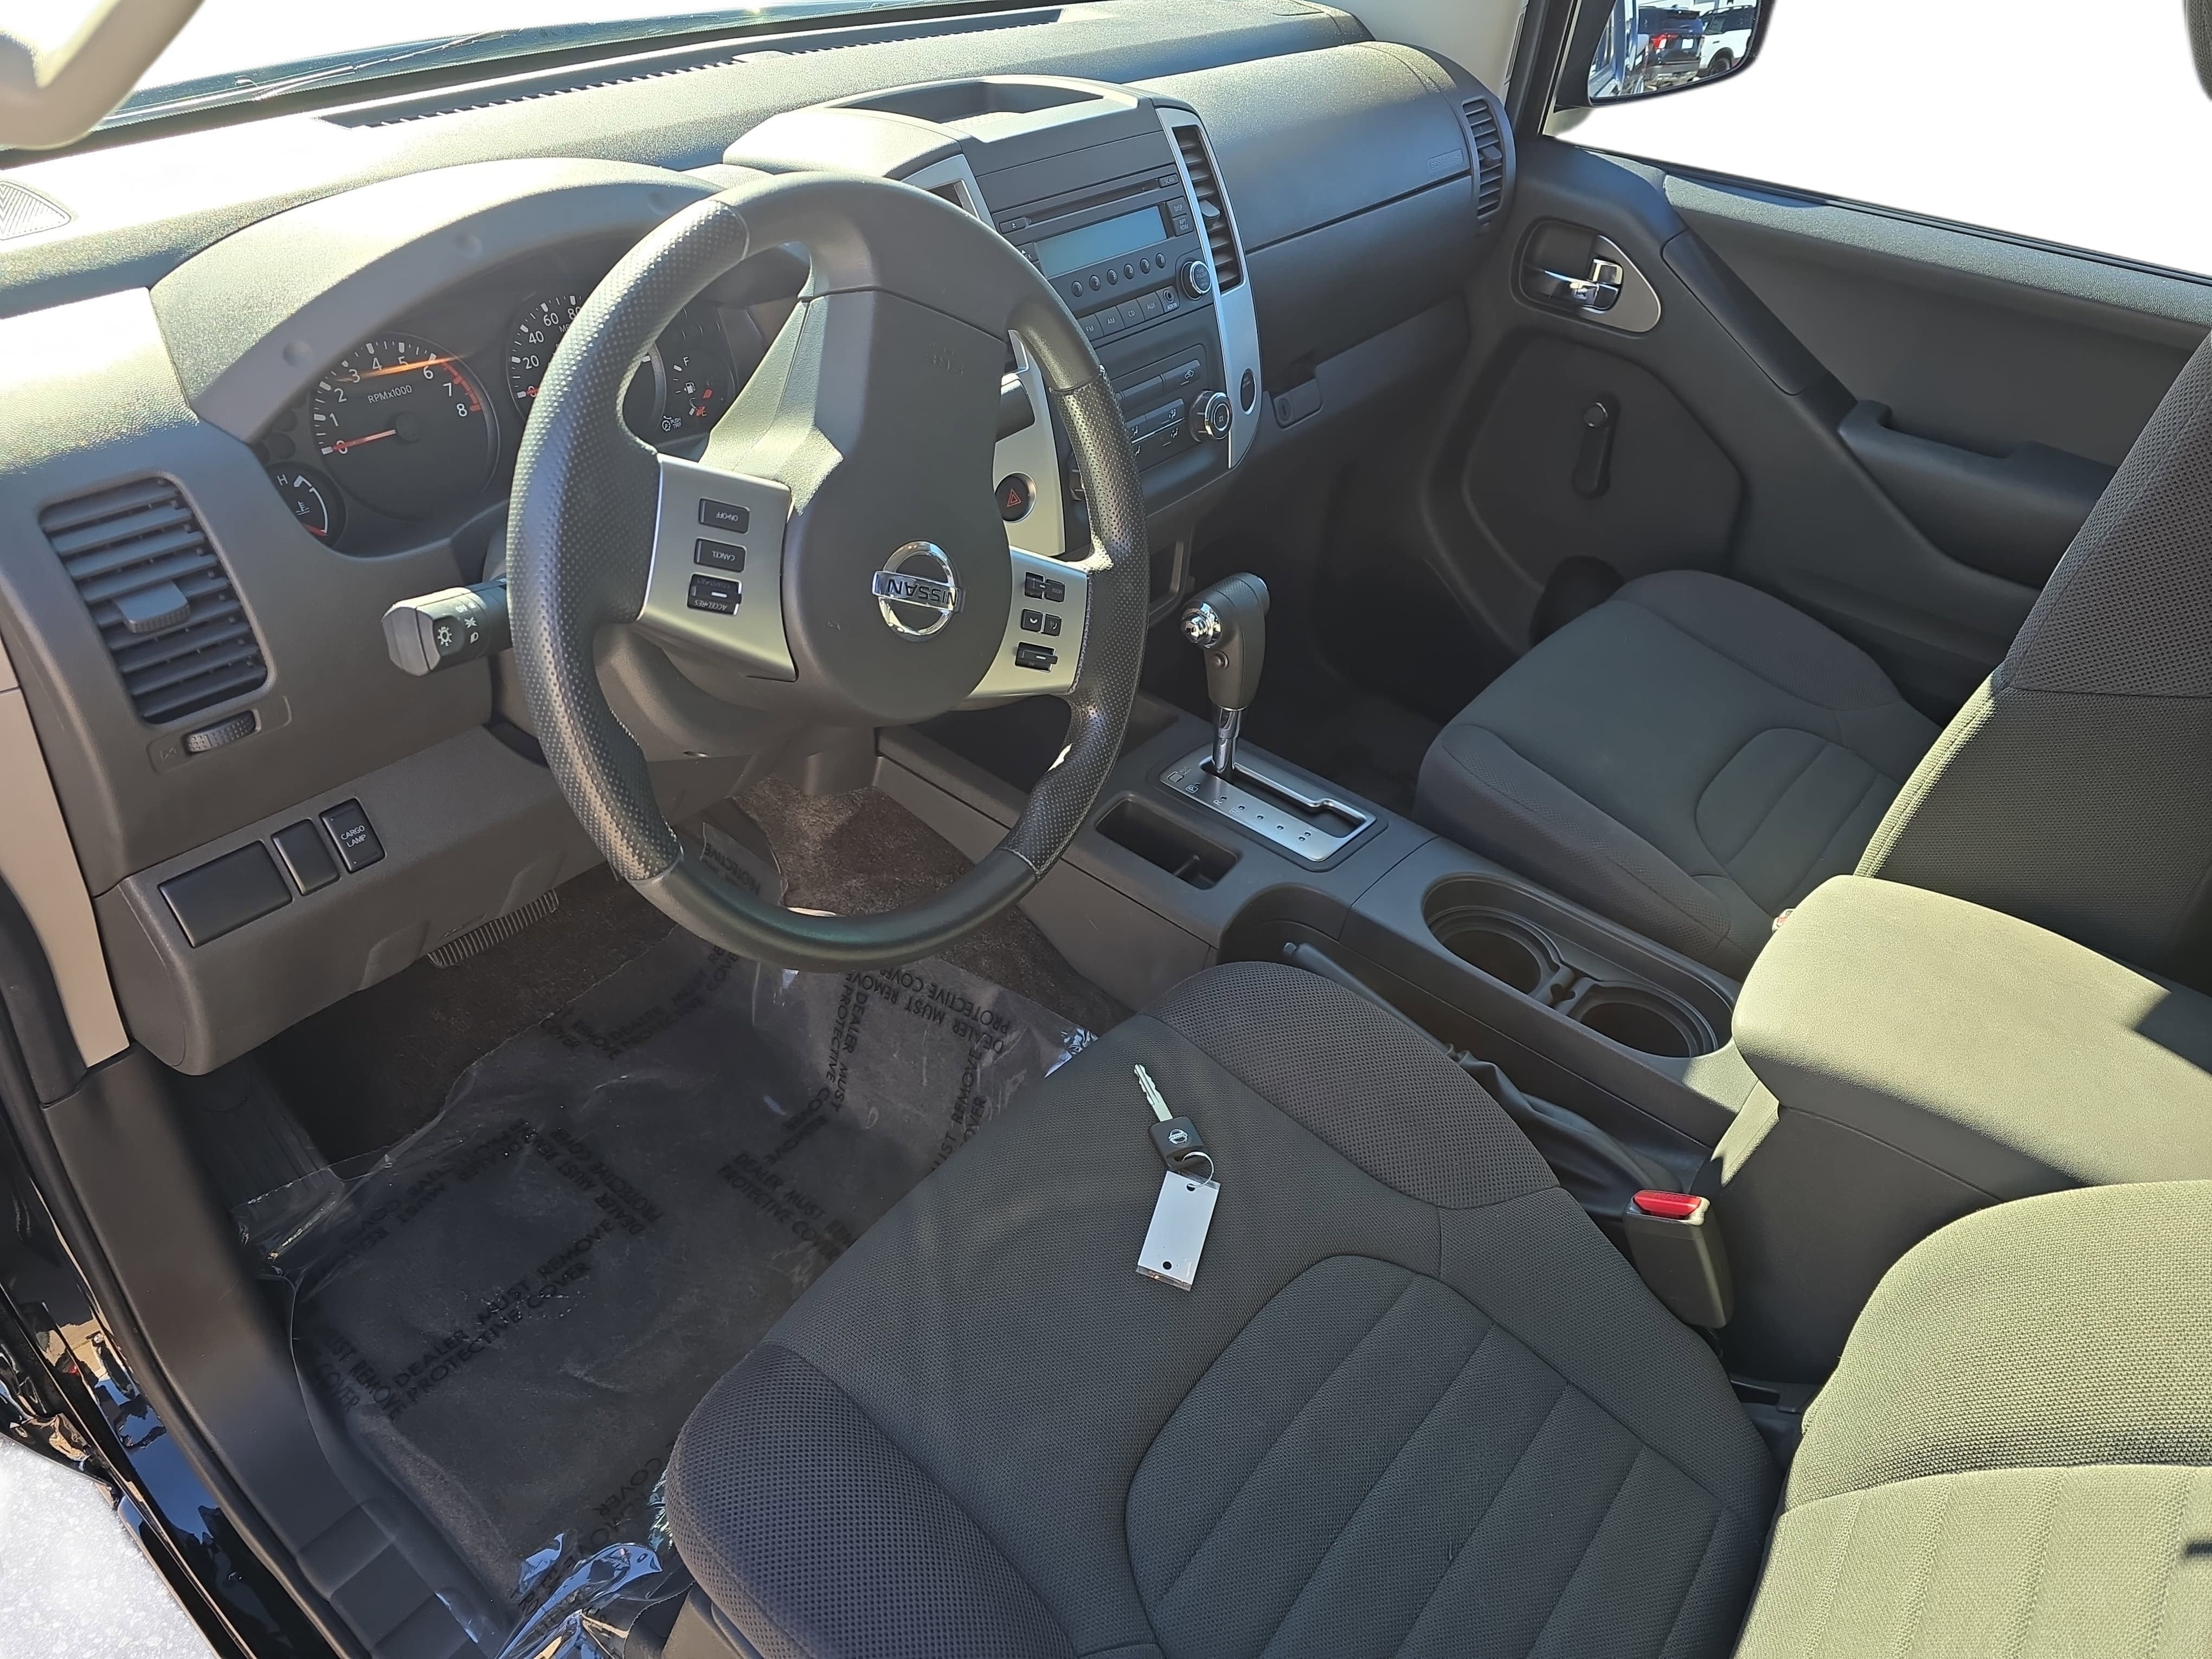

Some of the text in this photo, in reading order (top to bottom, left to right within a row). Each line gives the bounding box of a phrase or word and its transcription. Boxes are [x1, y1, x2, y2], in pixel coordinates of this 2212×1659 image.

[543, 312, 559, 326] 60
[529, 330, 544, 344] 40
[372, 357, 382, 370] 4
[423, 365, 434, 380] 6
[522, 355, 539, 369] 20
[683, 356, 690, 366] F
[348, 369, 361, 384] 3
[443, 382, 453, 397] 7
[333, 388, 347, 403] 2
[368, 384, 413, 404] RPMx1000
[329, 413, 339, 427] 1
[456, 403, 468, 417] 8
[276, 473, 289, 486] H
[712, 550, 735, 562] CANCEL
[887, 578, 957, 607] NISSAN
[340, 825, 365, 840] CARGO
[346, 833, 367, 848] LAMP
[706, 951, 740, 992] COVE
[842, 991, 868, 1054] DEALER
[904, 996, 947, 1025] MUST
[928, 983, 1012, 1035] PROTECTIVE
[541, 1018, 581, 1049] COVER
[570, 1018, 623, 1061] REMOVE
[826, 984, 854, 1084] PROTECTIVE
[952, 1018, 1003, 1055] DEALER
[830, 1062, 850, 1113] MUST
[951, 1049, 982, 1125] REMOVE
[556, 1161, 597, 1191] MUST
[734, 1153, 827, 1220] DEALER MUST
[594, 1193, 645, 1235] DEALER
[394, 1219, 615, 1388] DEALER MUST REMOVE
[407, 1261, 592, 1403] PROTECTIVE COVER
[350, 1359, 407, 1421] REMOVE
[593, 1457, 663, 1516] COVER
